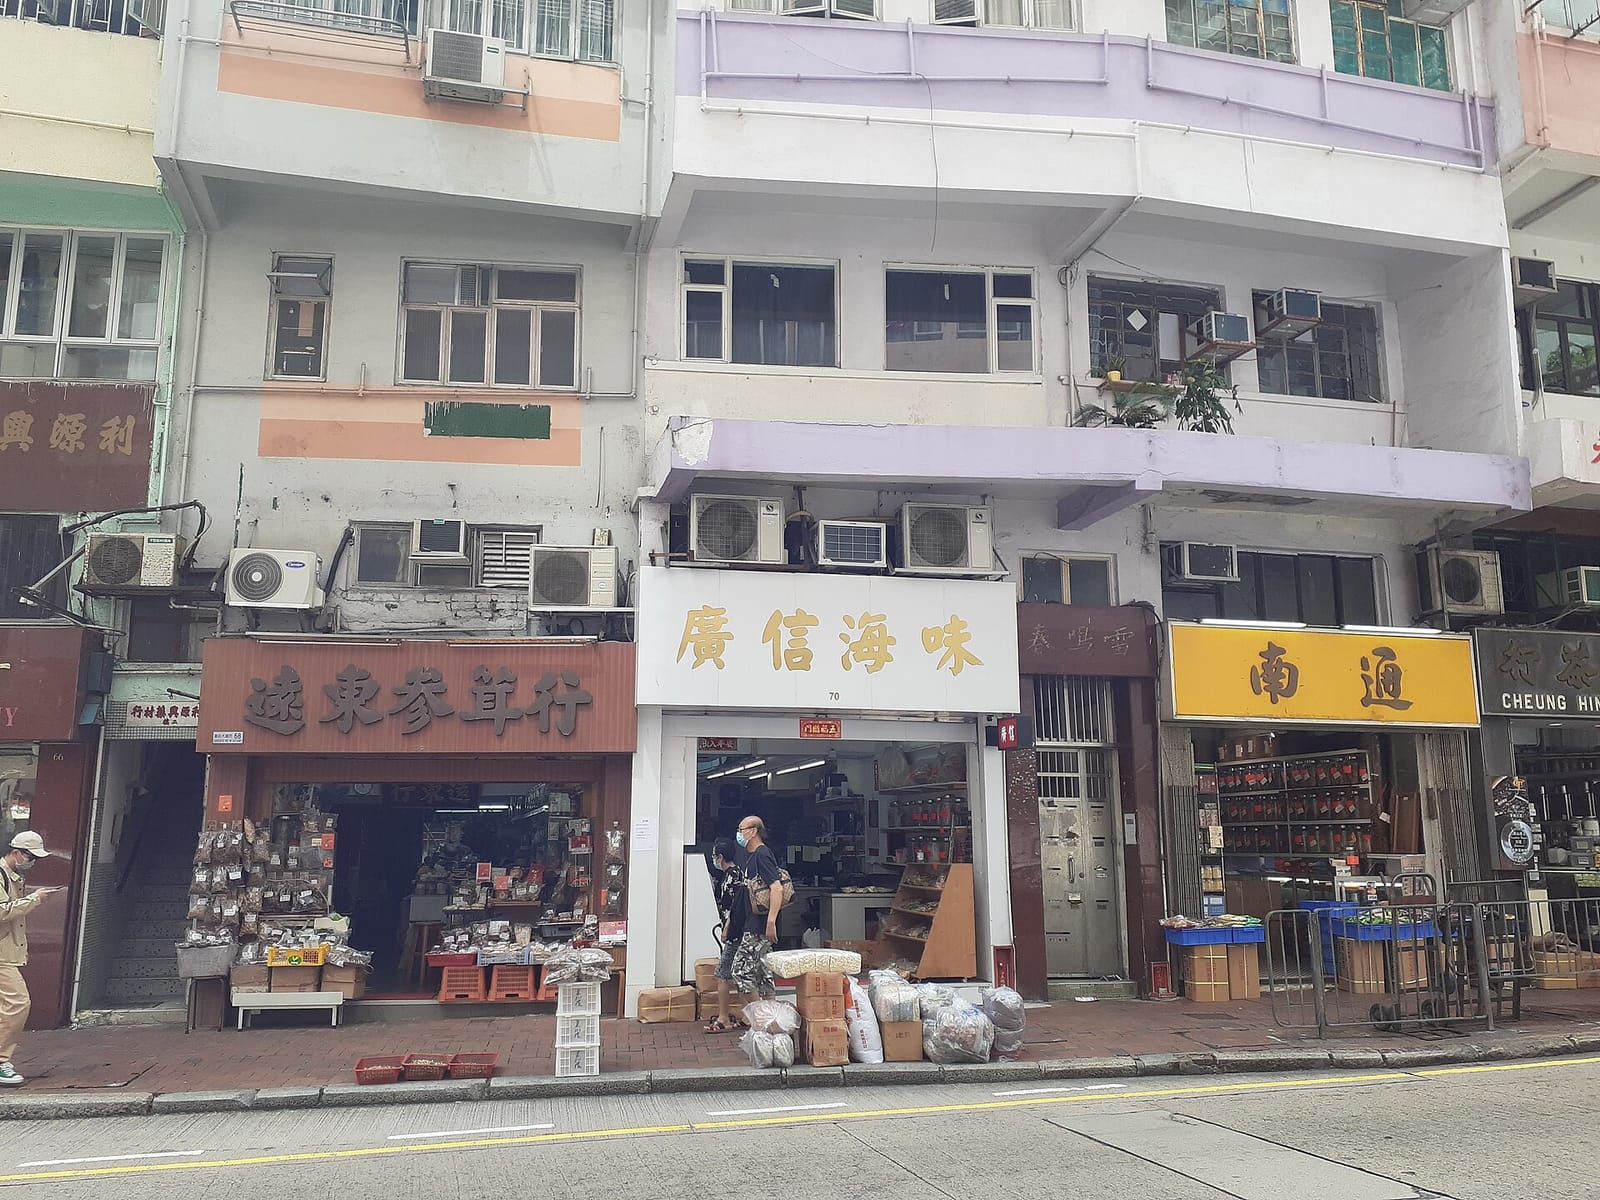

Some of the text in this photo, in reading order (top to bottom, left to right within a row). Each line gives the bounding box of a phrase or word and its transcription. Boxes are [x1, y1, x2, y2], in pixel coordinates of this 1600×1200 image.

[676, 604, 984, 676] 廣信海味
[1250, 640, 1414, 711] 南通
[829, 692, 840, 700] 70
[1502, 692, 1567, 710] CHEUNG
[0, 707, 18, 727] Y
[234, 732, 242, 740] 68
[53, 753, 64, 761] 66
